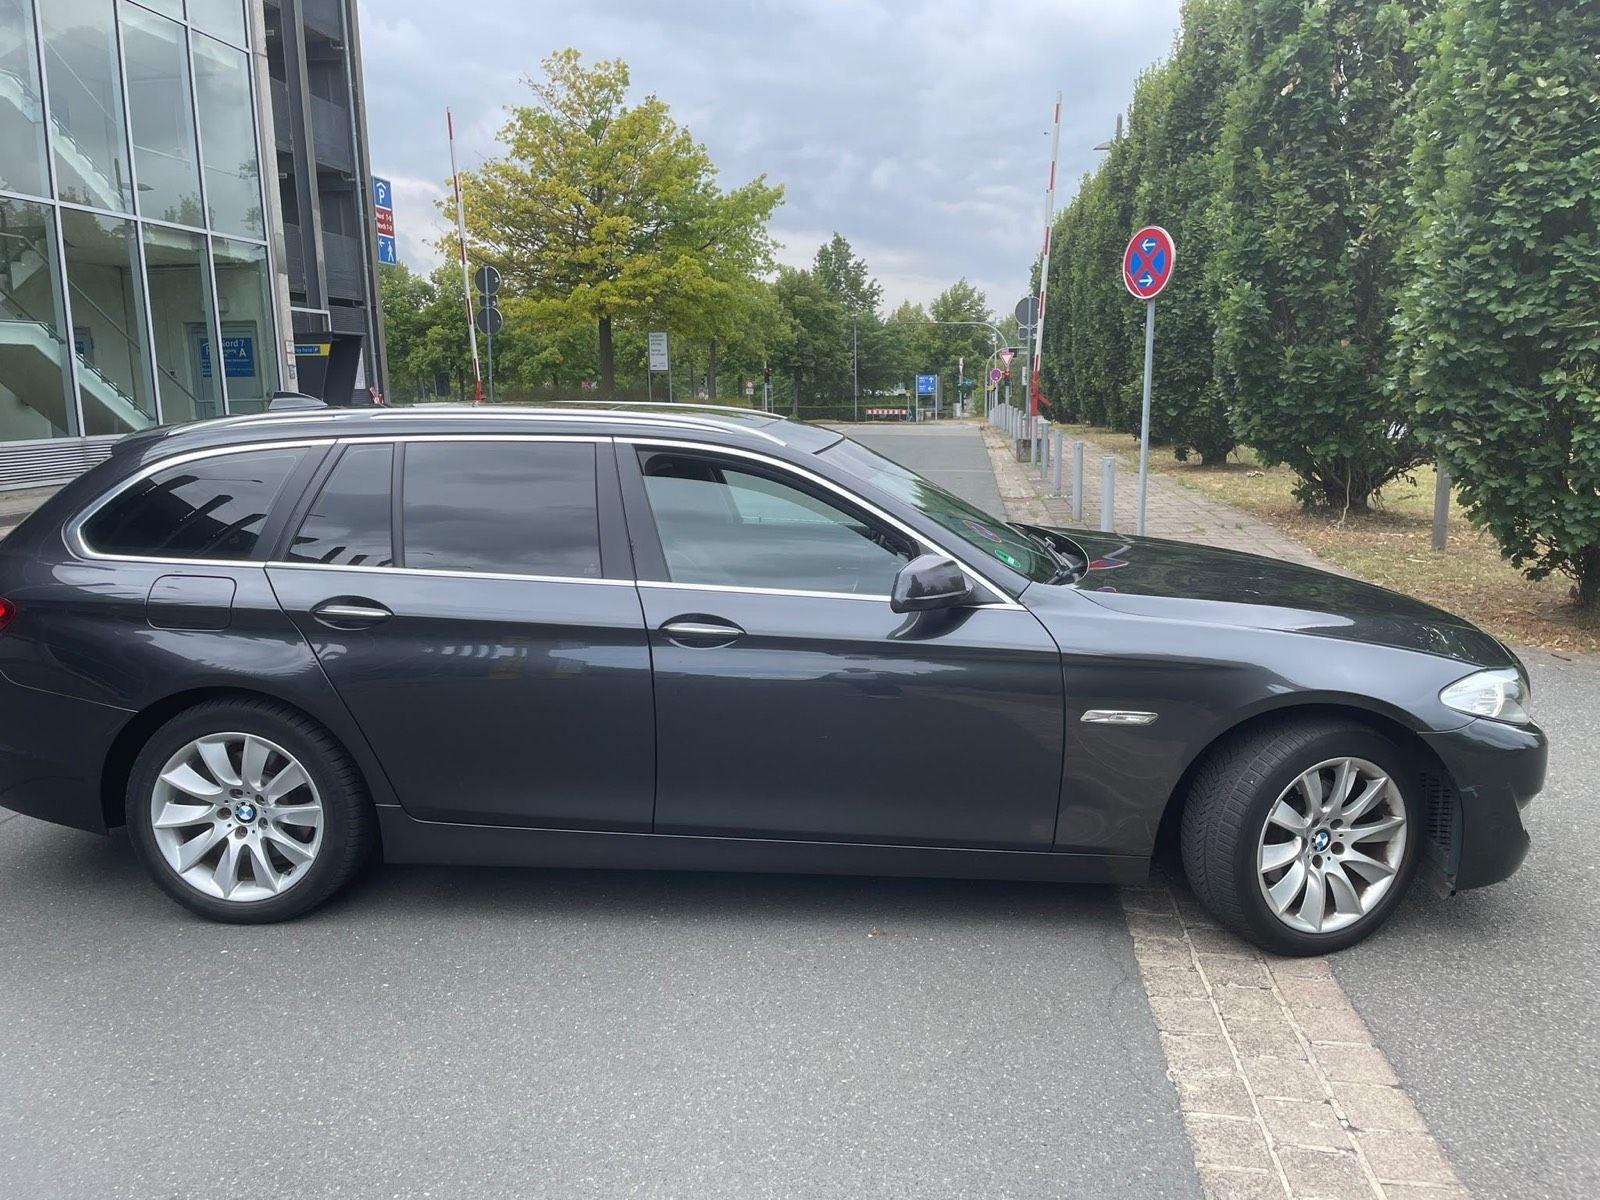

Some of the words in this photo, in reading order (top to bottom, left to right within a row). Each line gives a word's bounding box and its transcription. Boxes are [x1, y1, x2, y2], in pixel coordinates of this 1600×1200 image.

[379, 188, 385, 204] P
[239, 339, 245, 347] 7
[239, 348, 247, 358] A
